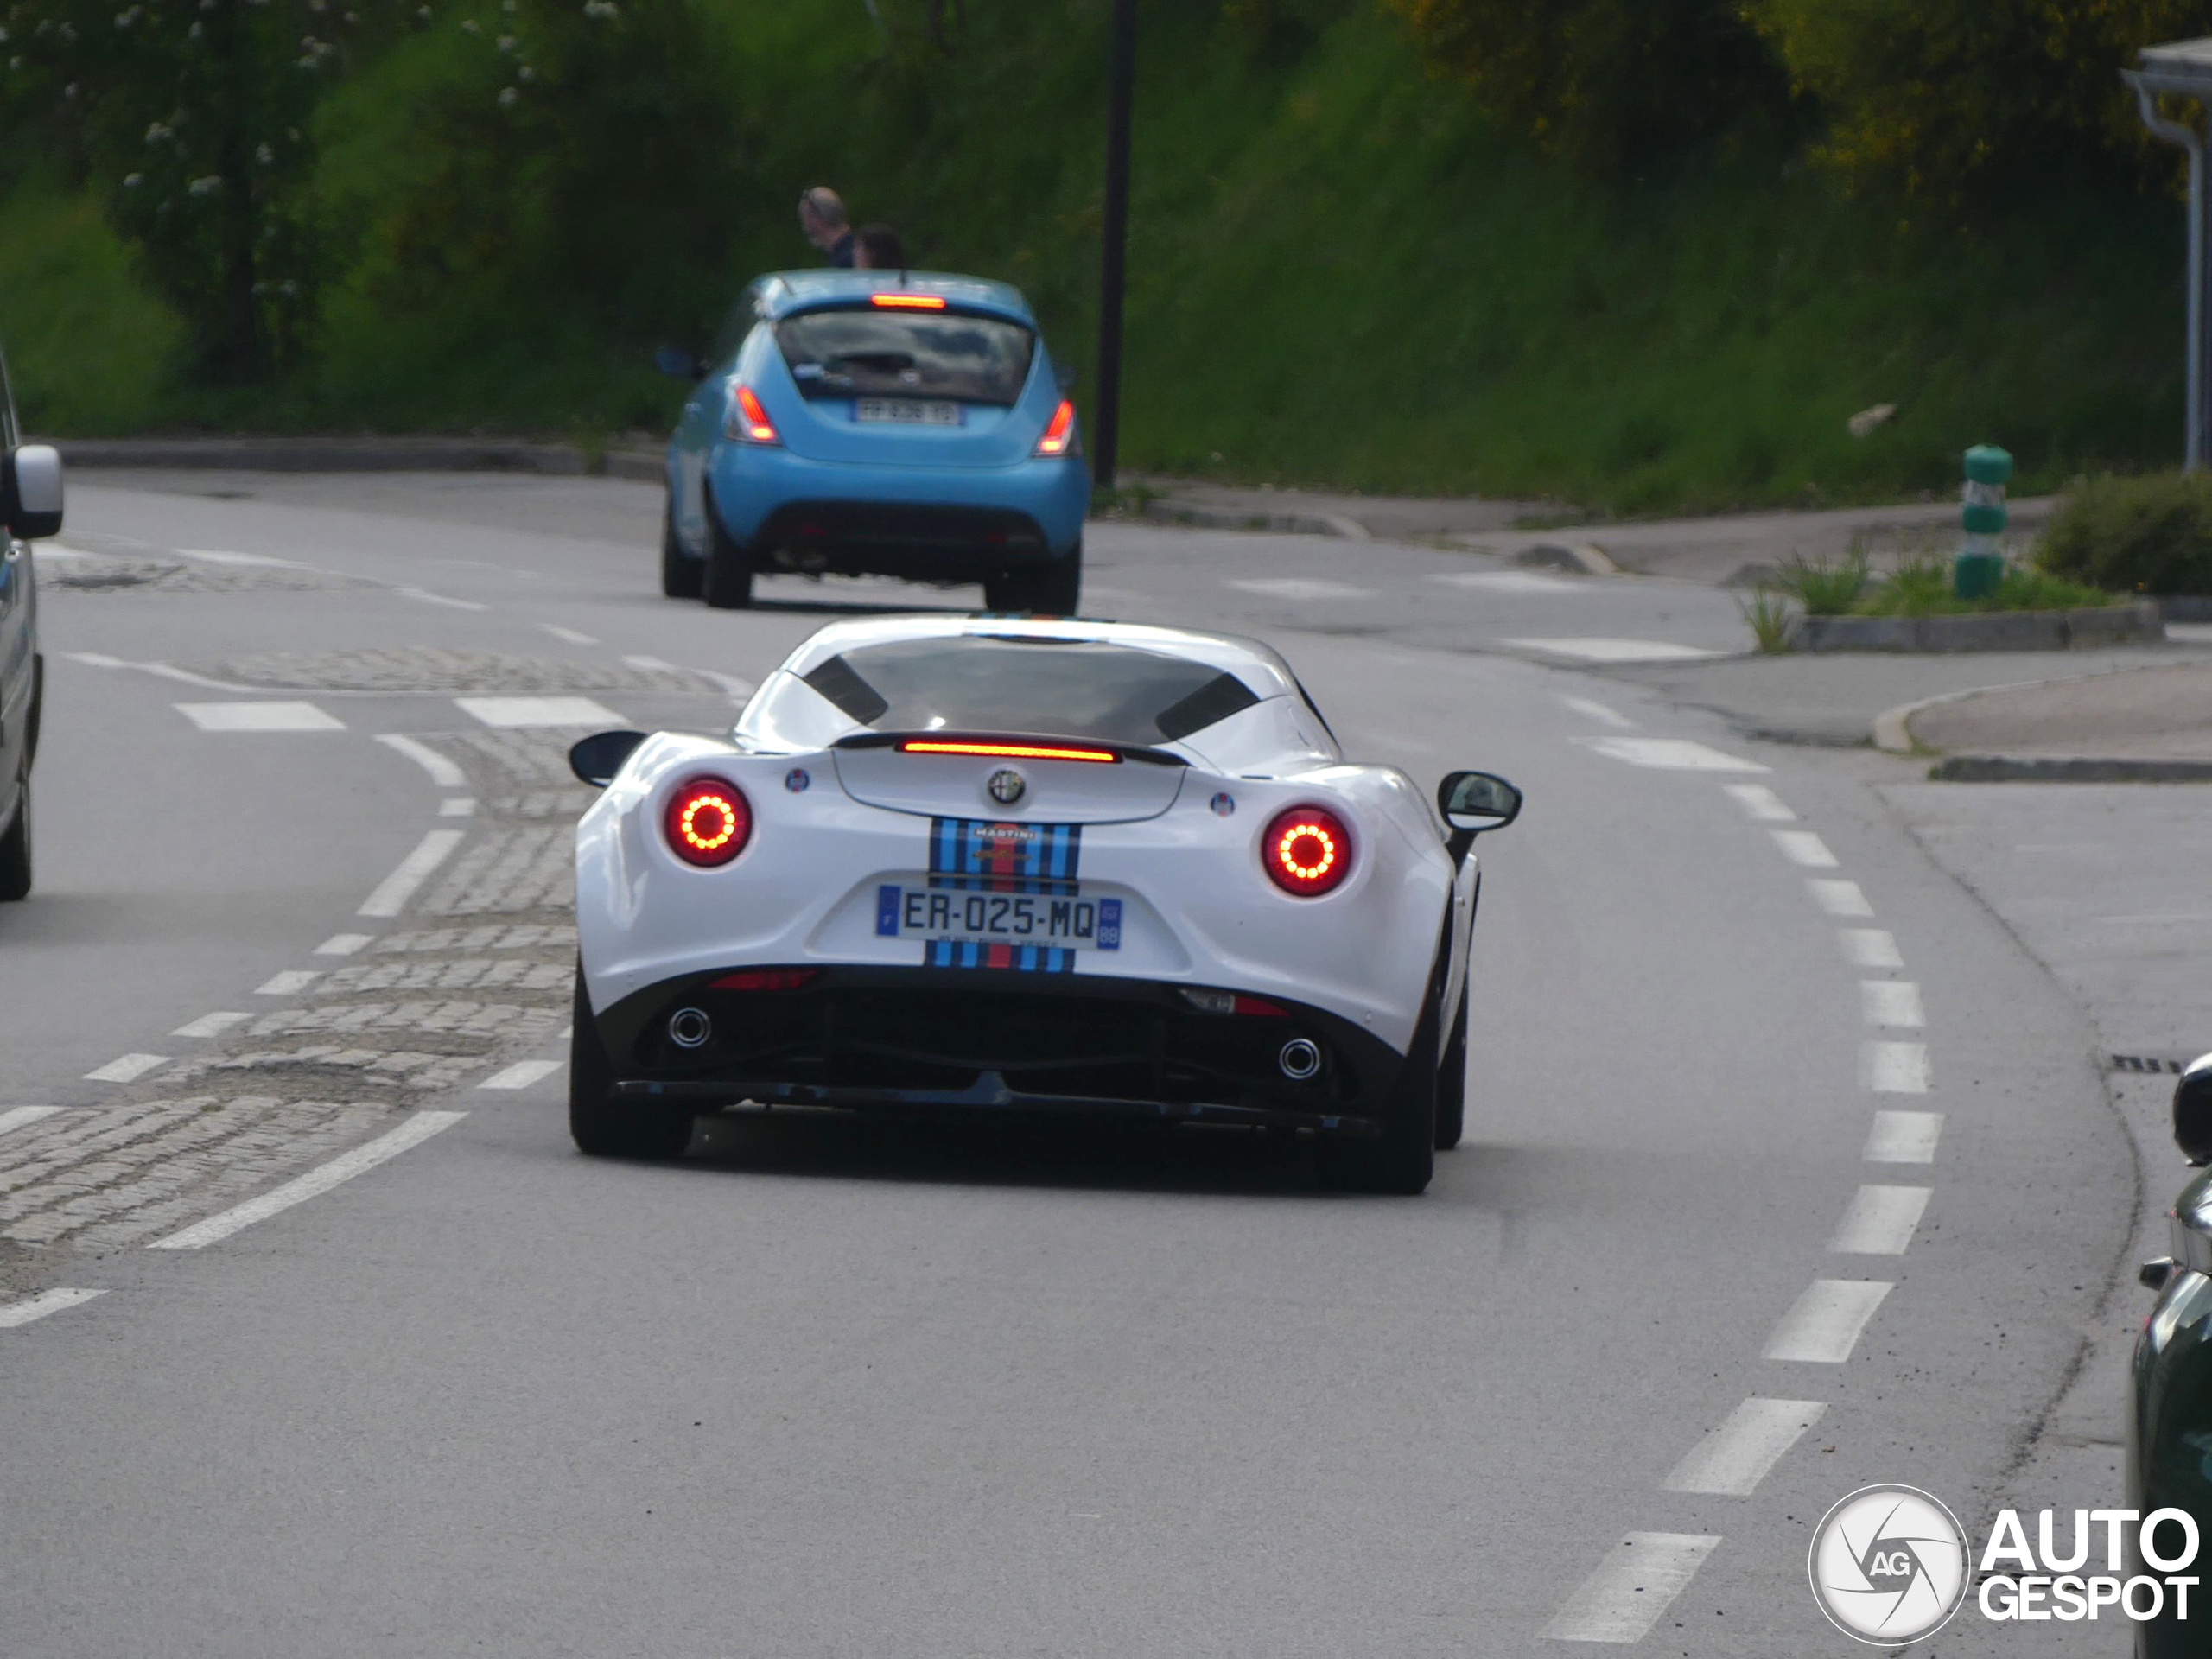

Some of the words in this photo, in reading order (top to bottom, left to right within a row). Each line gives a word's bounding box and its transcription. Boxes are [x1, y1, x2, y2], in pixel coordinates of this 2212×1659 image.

[975, 828, 1035, 839] MARTINI
[906, 893, 1094, 938] ER-025-MQ
[1099, 926, 1117, 944] 88
